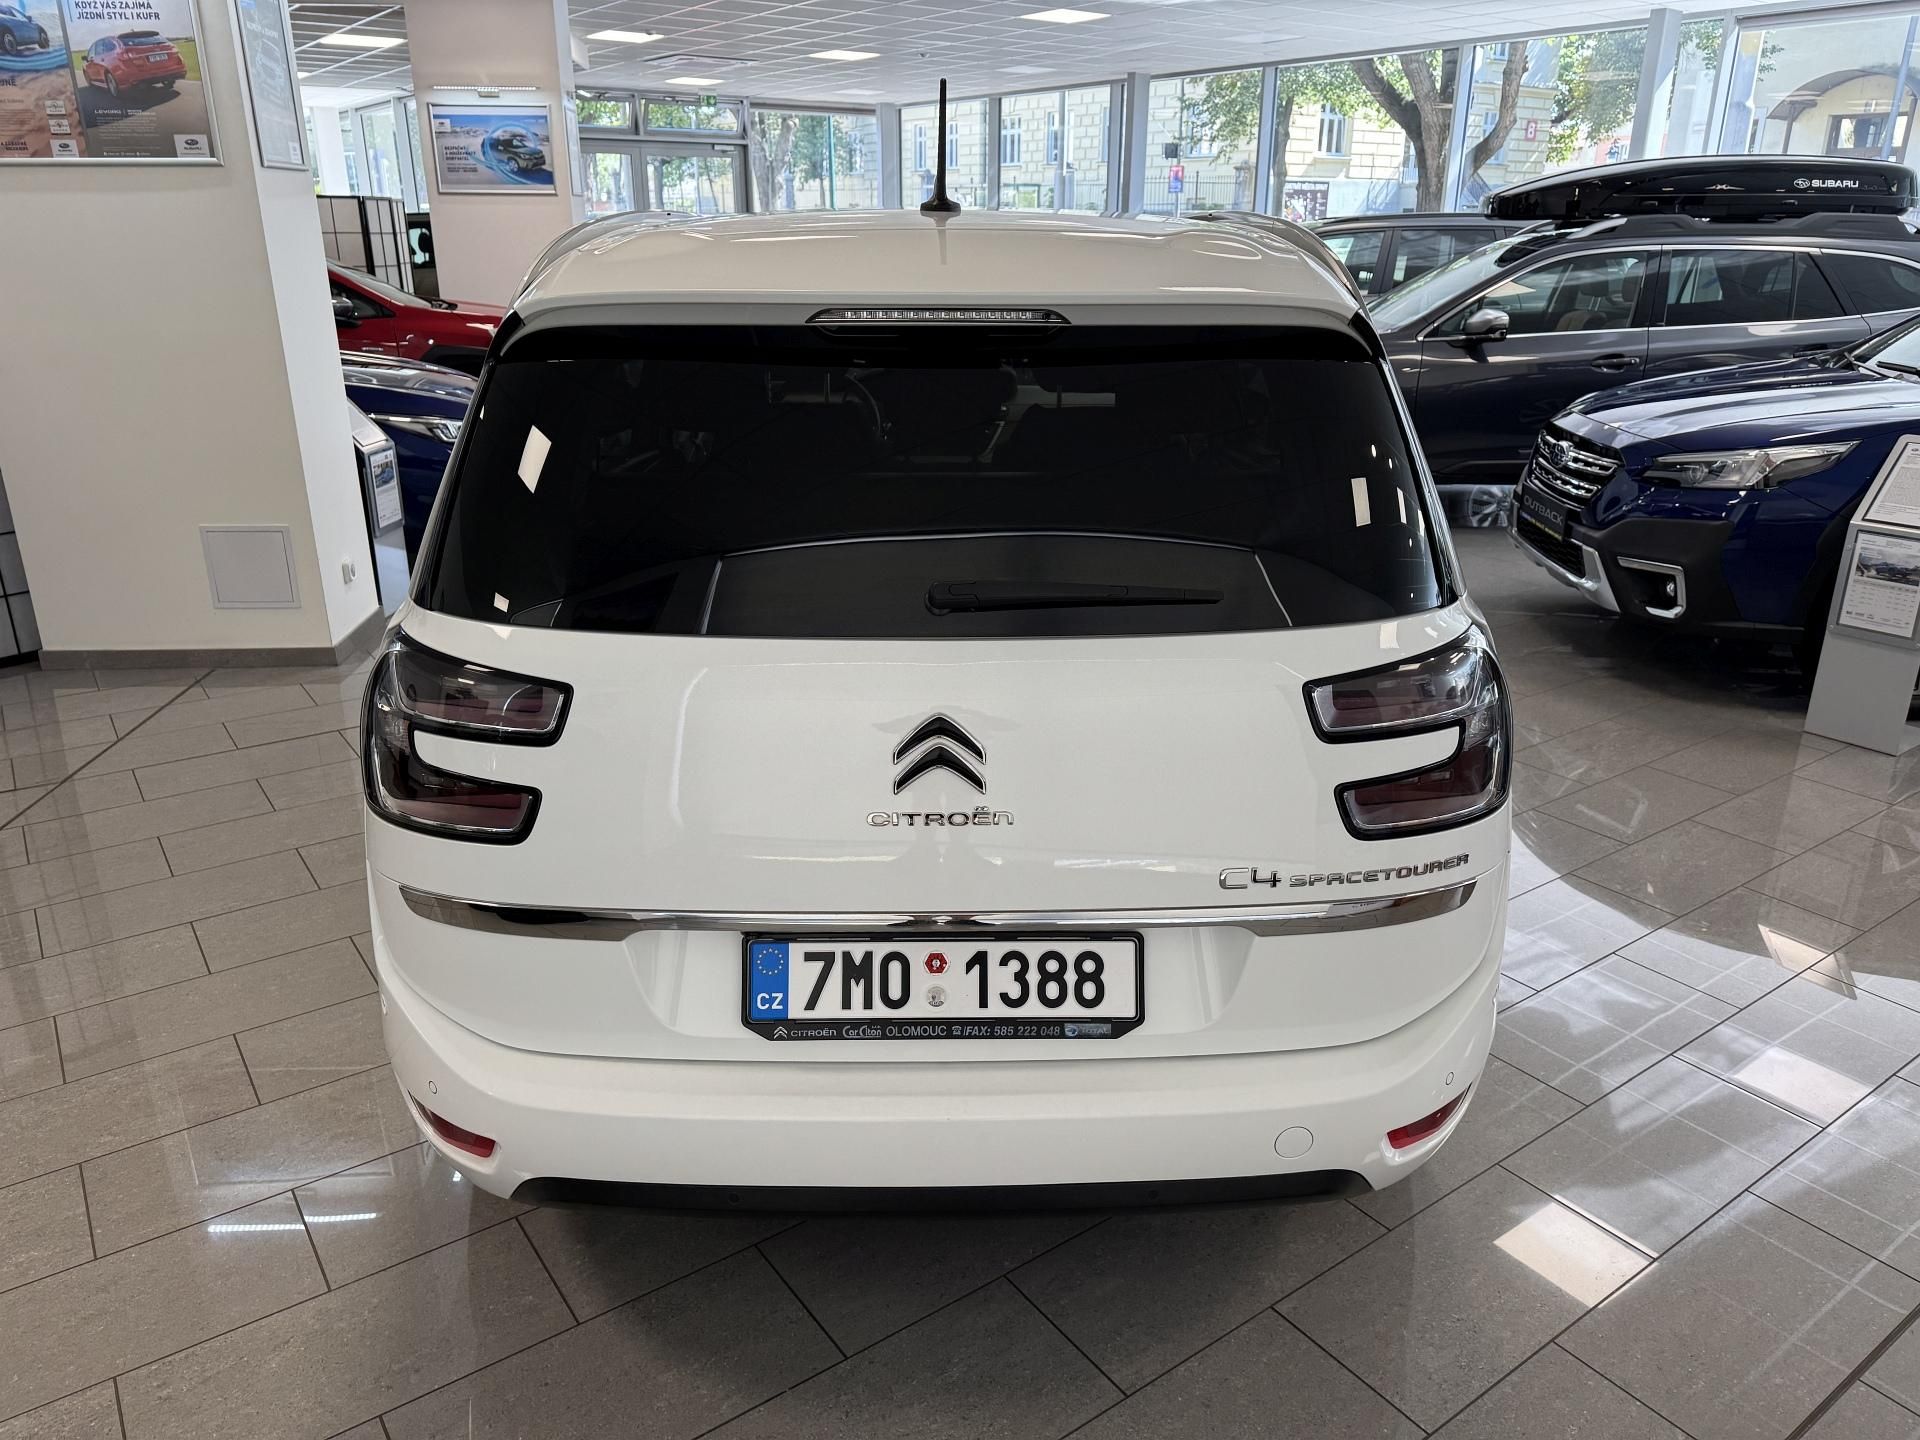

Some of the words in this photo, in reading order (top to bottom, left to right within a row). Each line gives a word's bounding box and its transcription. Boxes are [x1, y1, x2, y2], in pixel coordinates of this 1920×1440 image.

[77, 9, 105, 20] JÍZDNÍ
[107, 11, 129, 20] STYL
[136, 11, 160, 20] KUFR
[1811, 179, 1859, 188] SUBARU
[1523, 494, 1563, 525] OUTBACK
[866, 805, 1015, 827] CITROËN
[1218, 865, 1282, 890] C4
[1289, 852, 1470, 888] SPACETOURER
[965, 950, 1105, 1009] 1388
[756, 992, 784, 1010] CZ
[886, 1025, 947, 1036] OLOMOUC
[994, 1025, 1014, 1036] 585
[1017, 1025, 1037, 1036] 222
[1040, 1025, 1060, 1036] 048
